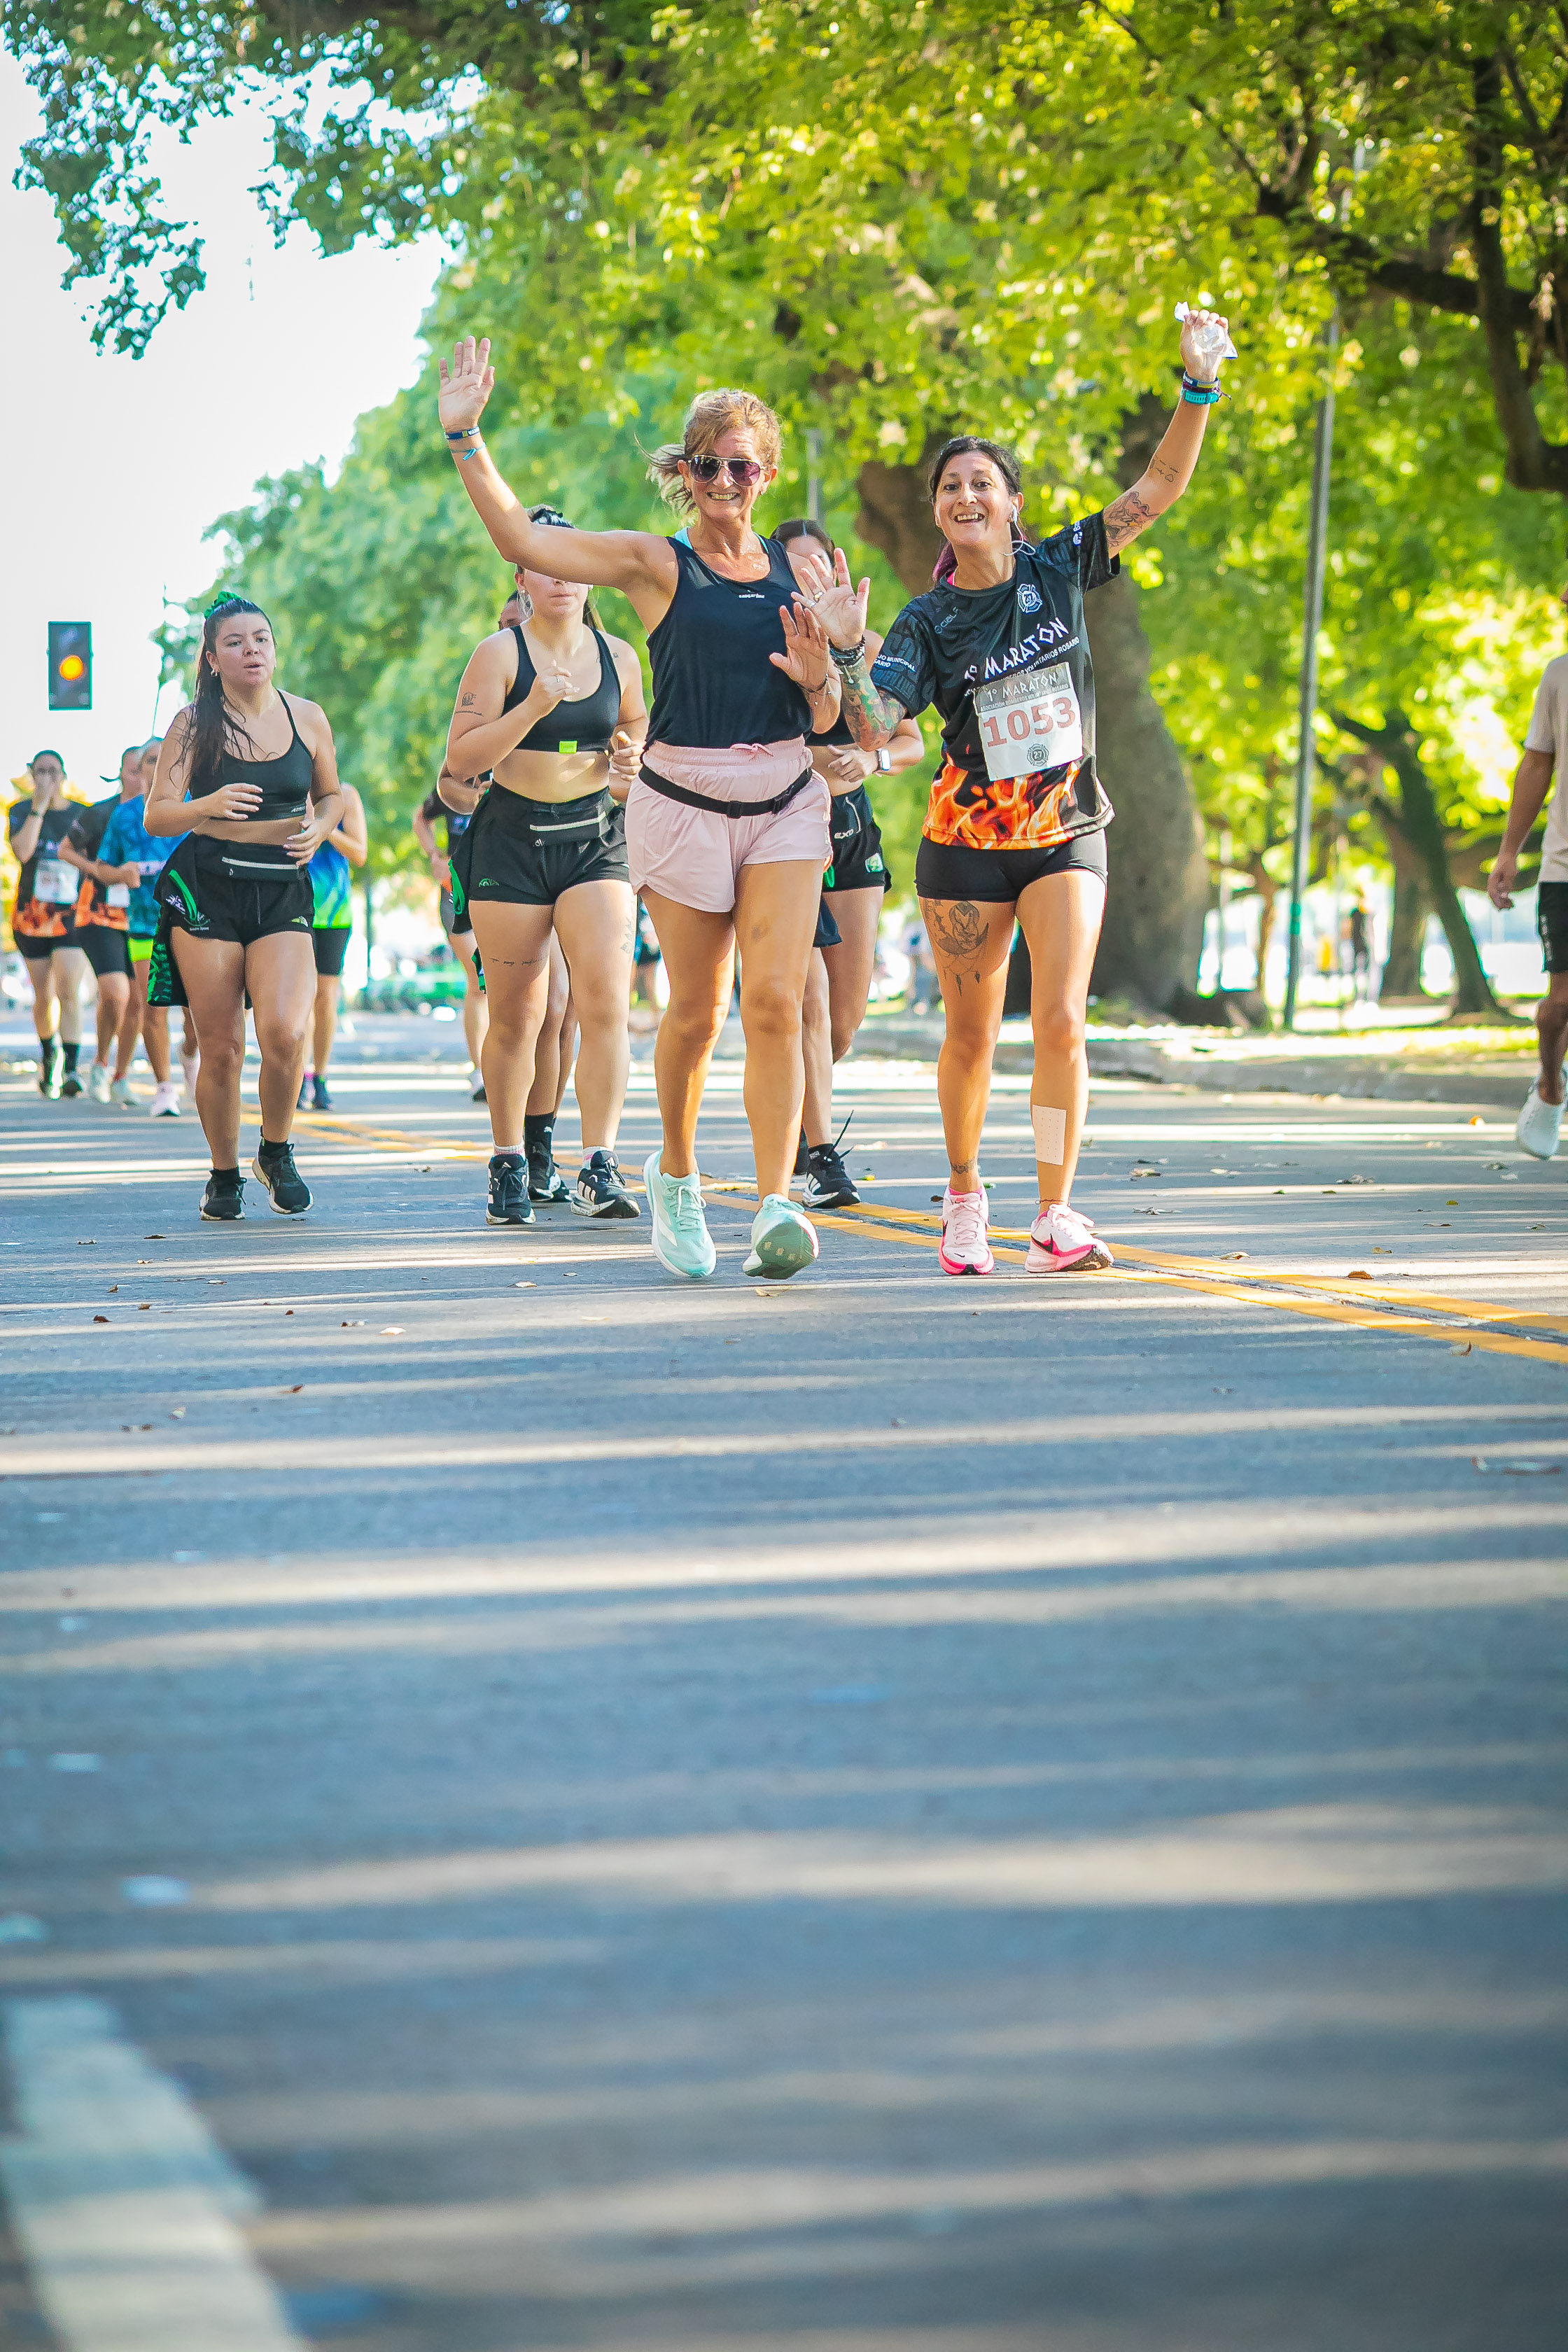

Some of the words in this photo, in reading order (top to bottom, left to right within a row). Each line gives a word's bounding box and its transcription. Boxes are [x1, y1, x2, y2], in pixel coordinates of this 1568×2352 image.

[984, 617, 1069, 680] MARATÓN
[1058, 636, 1080, 654] ROSARIO
[886, 656, 916, 673] MUNICIPAL
[1002, 671, 1058, 699] MARATÓN
[983, 696, 1076, 748] 1053
[1033, 750, 1042, 760] 27
